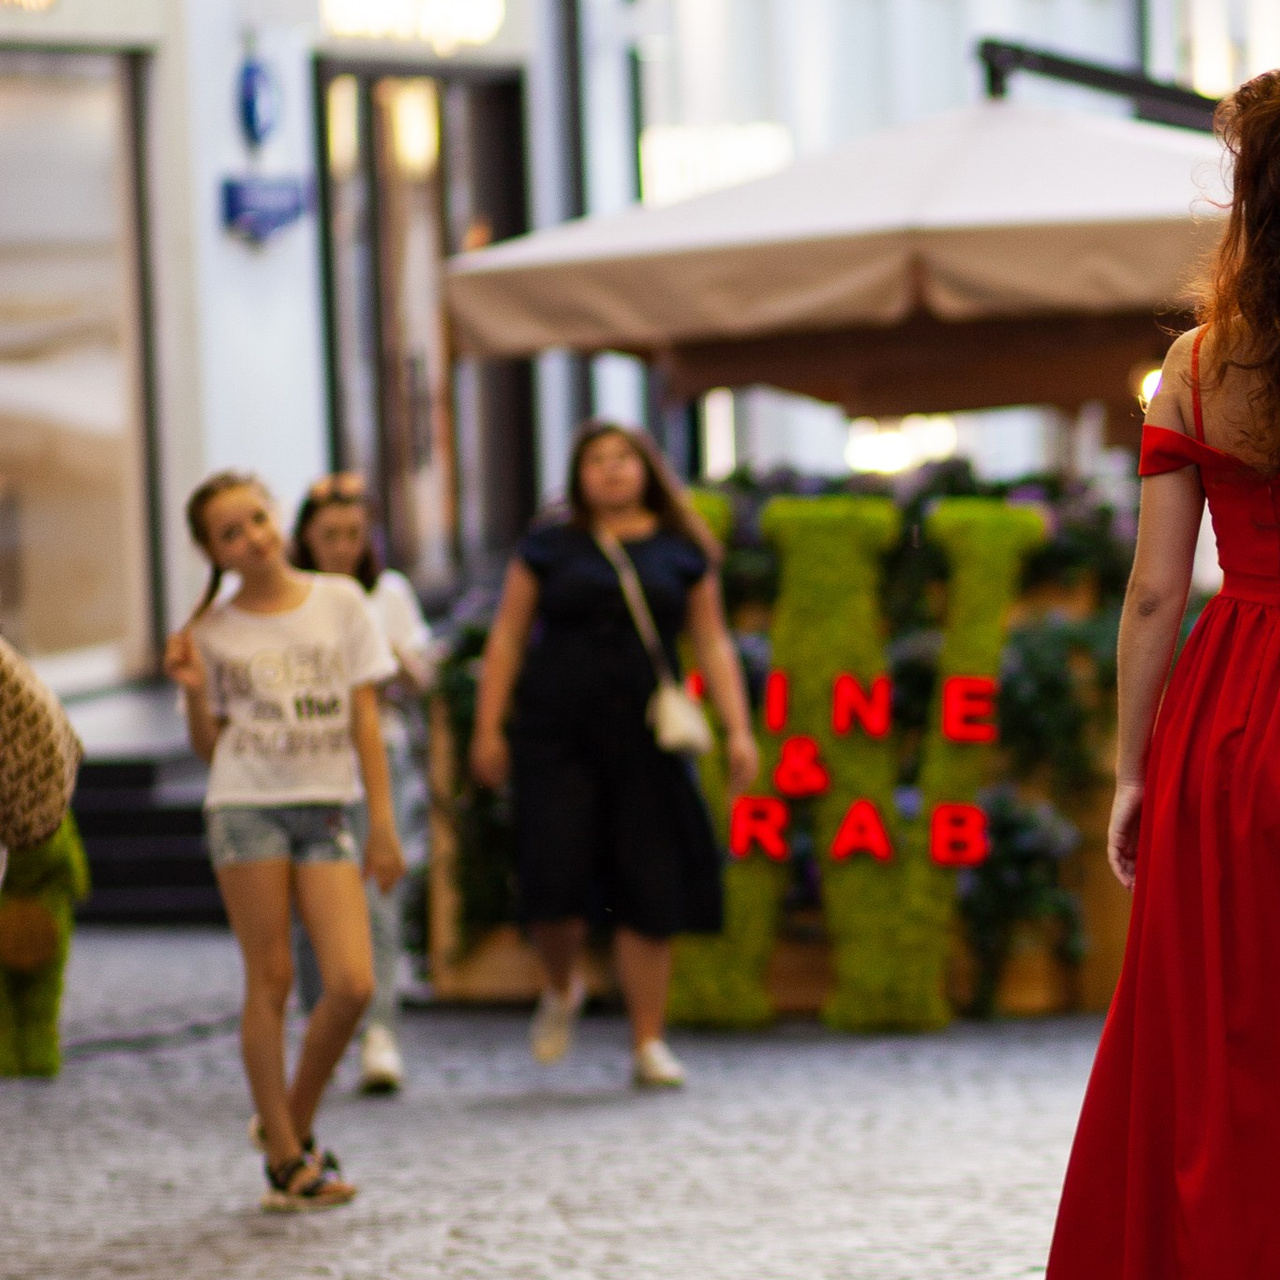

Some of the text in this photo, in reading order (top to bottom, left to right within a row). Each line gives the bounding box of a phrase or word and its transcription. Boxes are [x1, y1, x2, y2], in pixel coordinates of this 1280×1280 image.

[685, 668, 997, 743] INE
[772, 734, 829, 795] &
[729, 792, 988, 864] RAB
